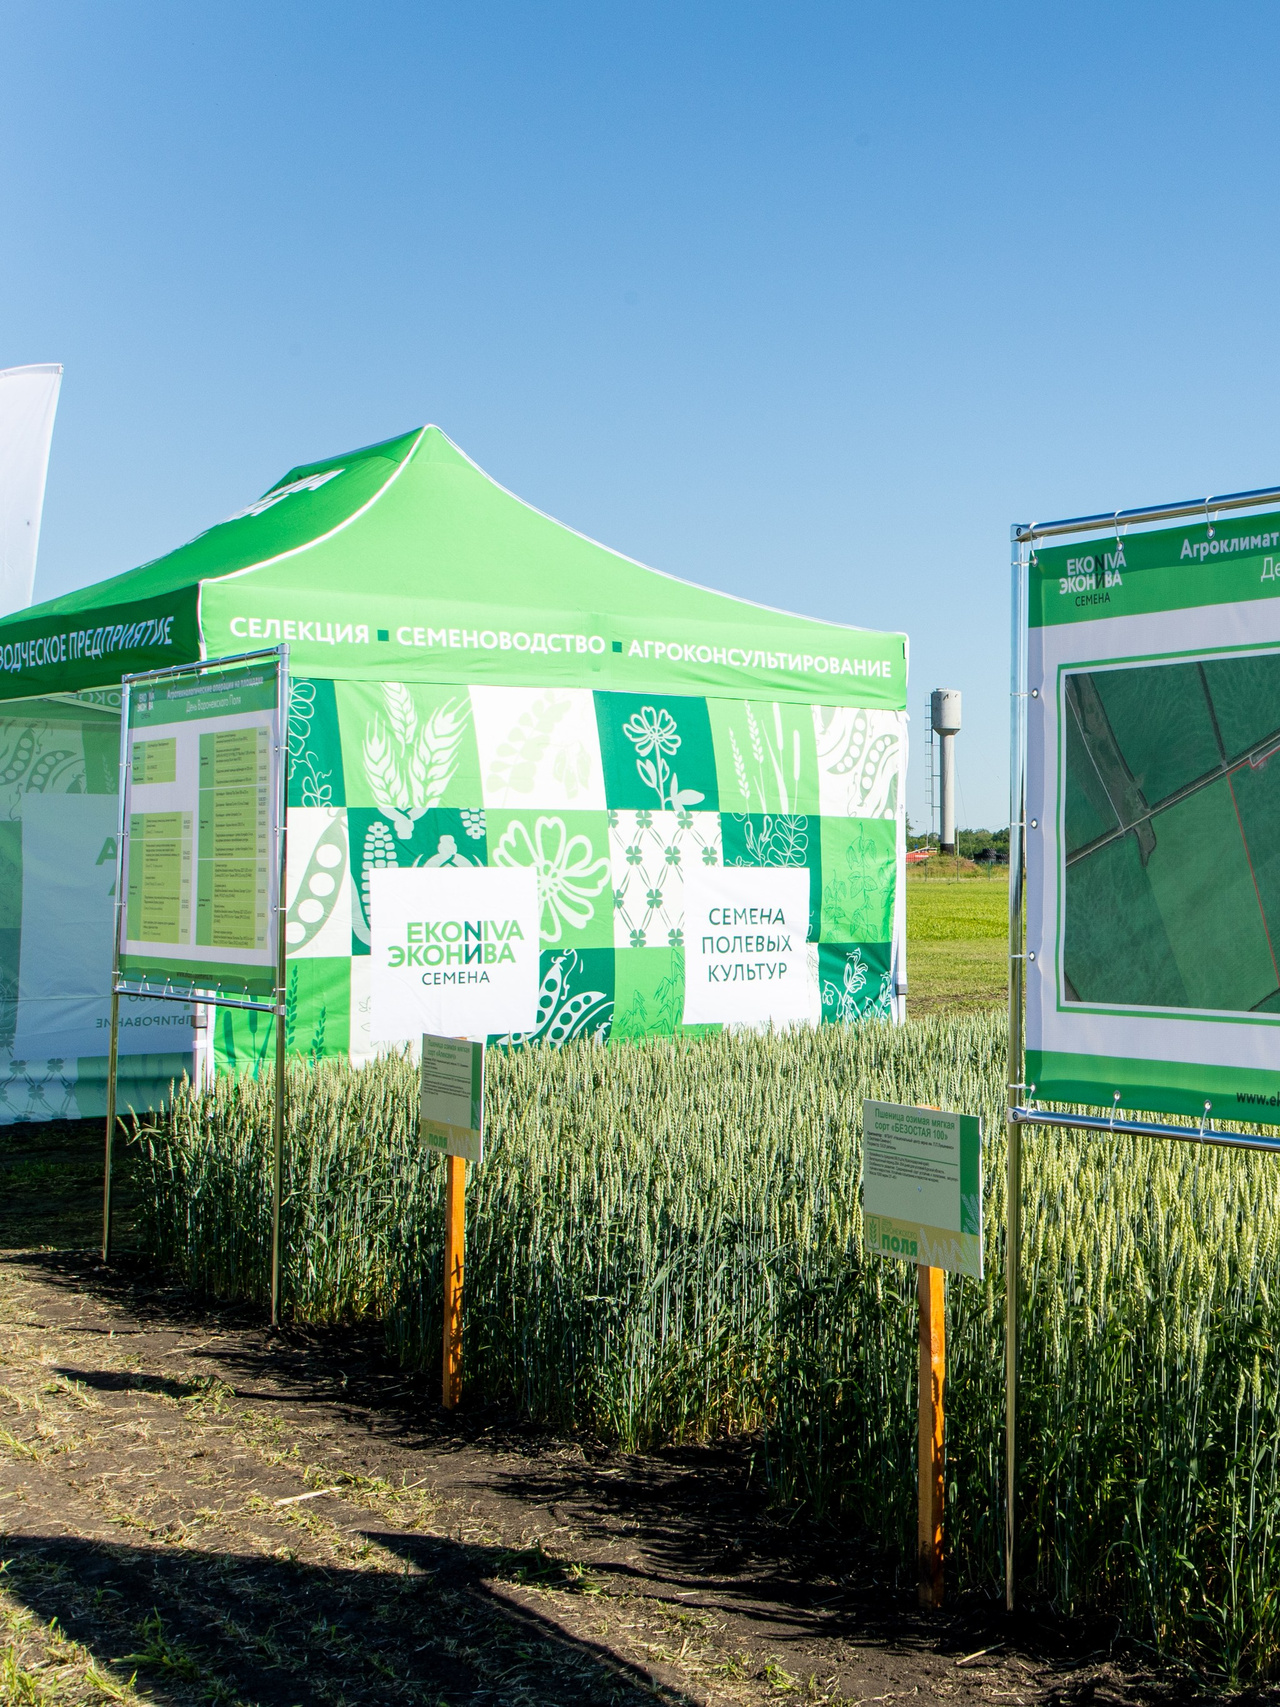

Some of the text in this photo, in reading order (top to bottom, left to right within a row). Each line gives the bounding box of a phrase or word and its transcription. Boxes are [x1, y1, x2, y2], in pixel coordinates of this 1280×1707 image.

[1067, 551, 1126, 575] EKONIVA
[1059, 570, 1122, 594] ЭКОНИВА
[1075, 592, 1110, 606] СЕМЕНА
[69, 616, 174, 659] ПРЕДПРИЯТИЕ
[229, 616, 891, 679] СЕЛЕКЦИЯ СЕМЕНОВОДСТВО АГРОКОНСУЛЬТИРОВАНИЕ
[709, 907, 785, 926] СЕМЕНА
[407, 920, 524, 942] EKONIVA
[388, 943, 516, 967] ЭКОНИВА
[702, 935, 792, 954] ПОЛЕВЫХ
[422, 970, 490, 985] СЕМЕНА
[708, 963, 786, 983] КУЛЬТУР
[875, 1108, 954, 1129] Пшеница озимая мягкая
[875, 1123, 889, 1132] сорт
[891, 1124, 931, 1138] «БЕЗОСТАЯ
[933, 1130, 948, 1140] 100»
[882, 1233, 918, 1256] ПОЛЯ
